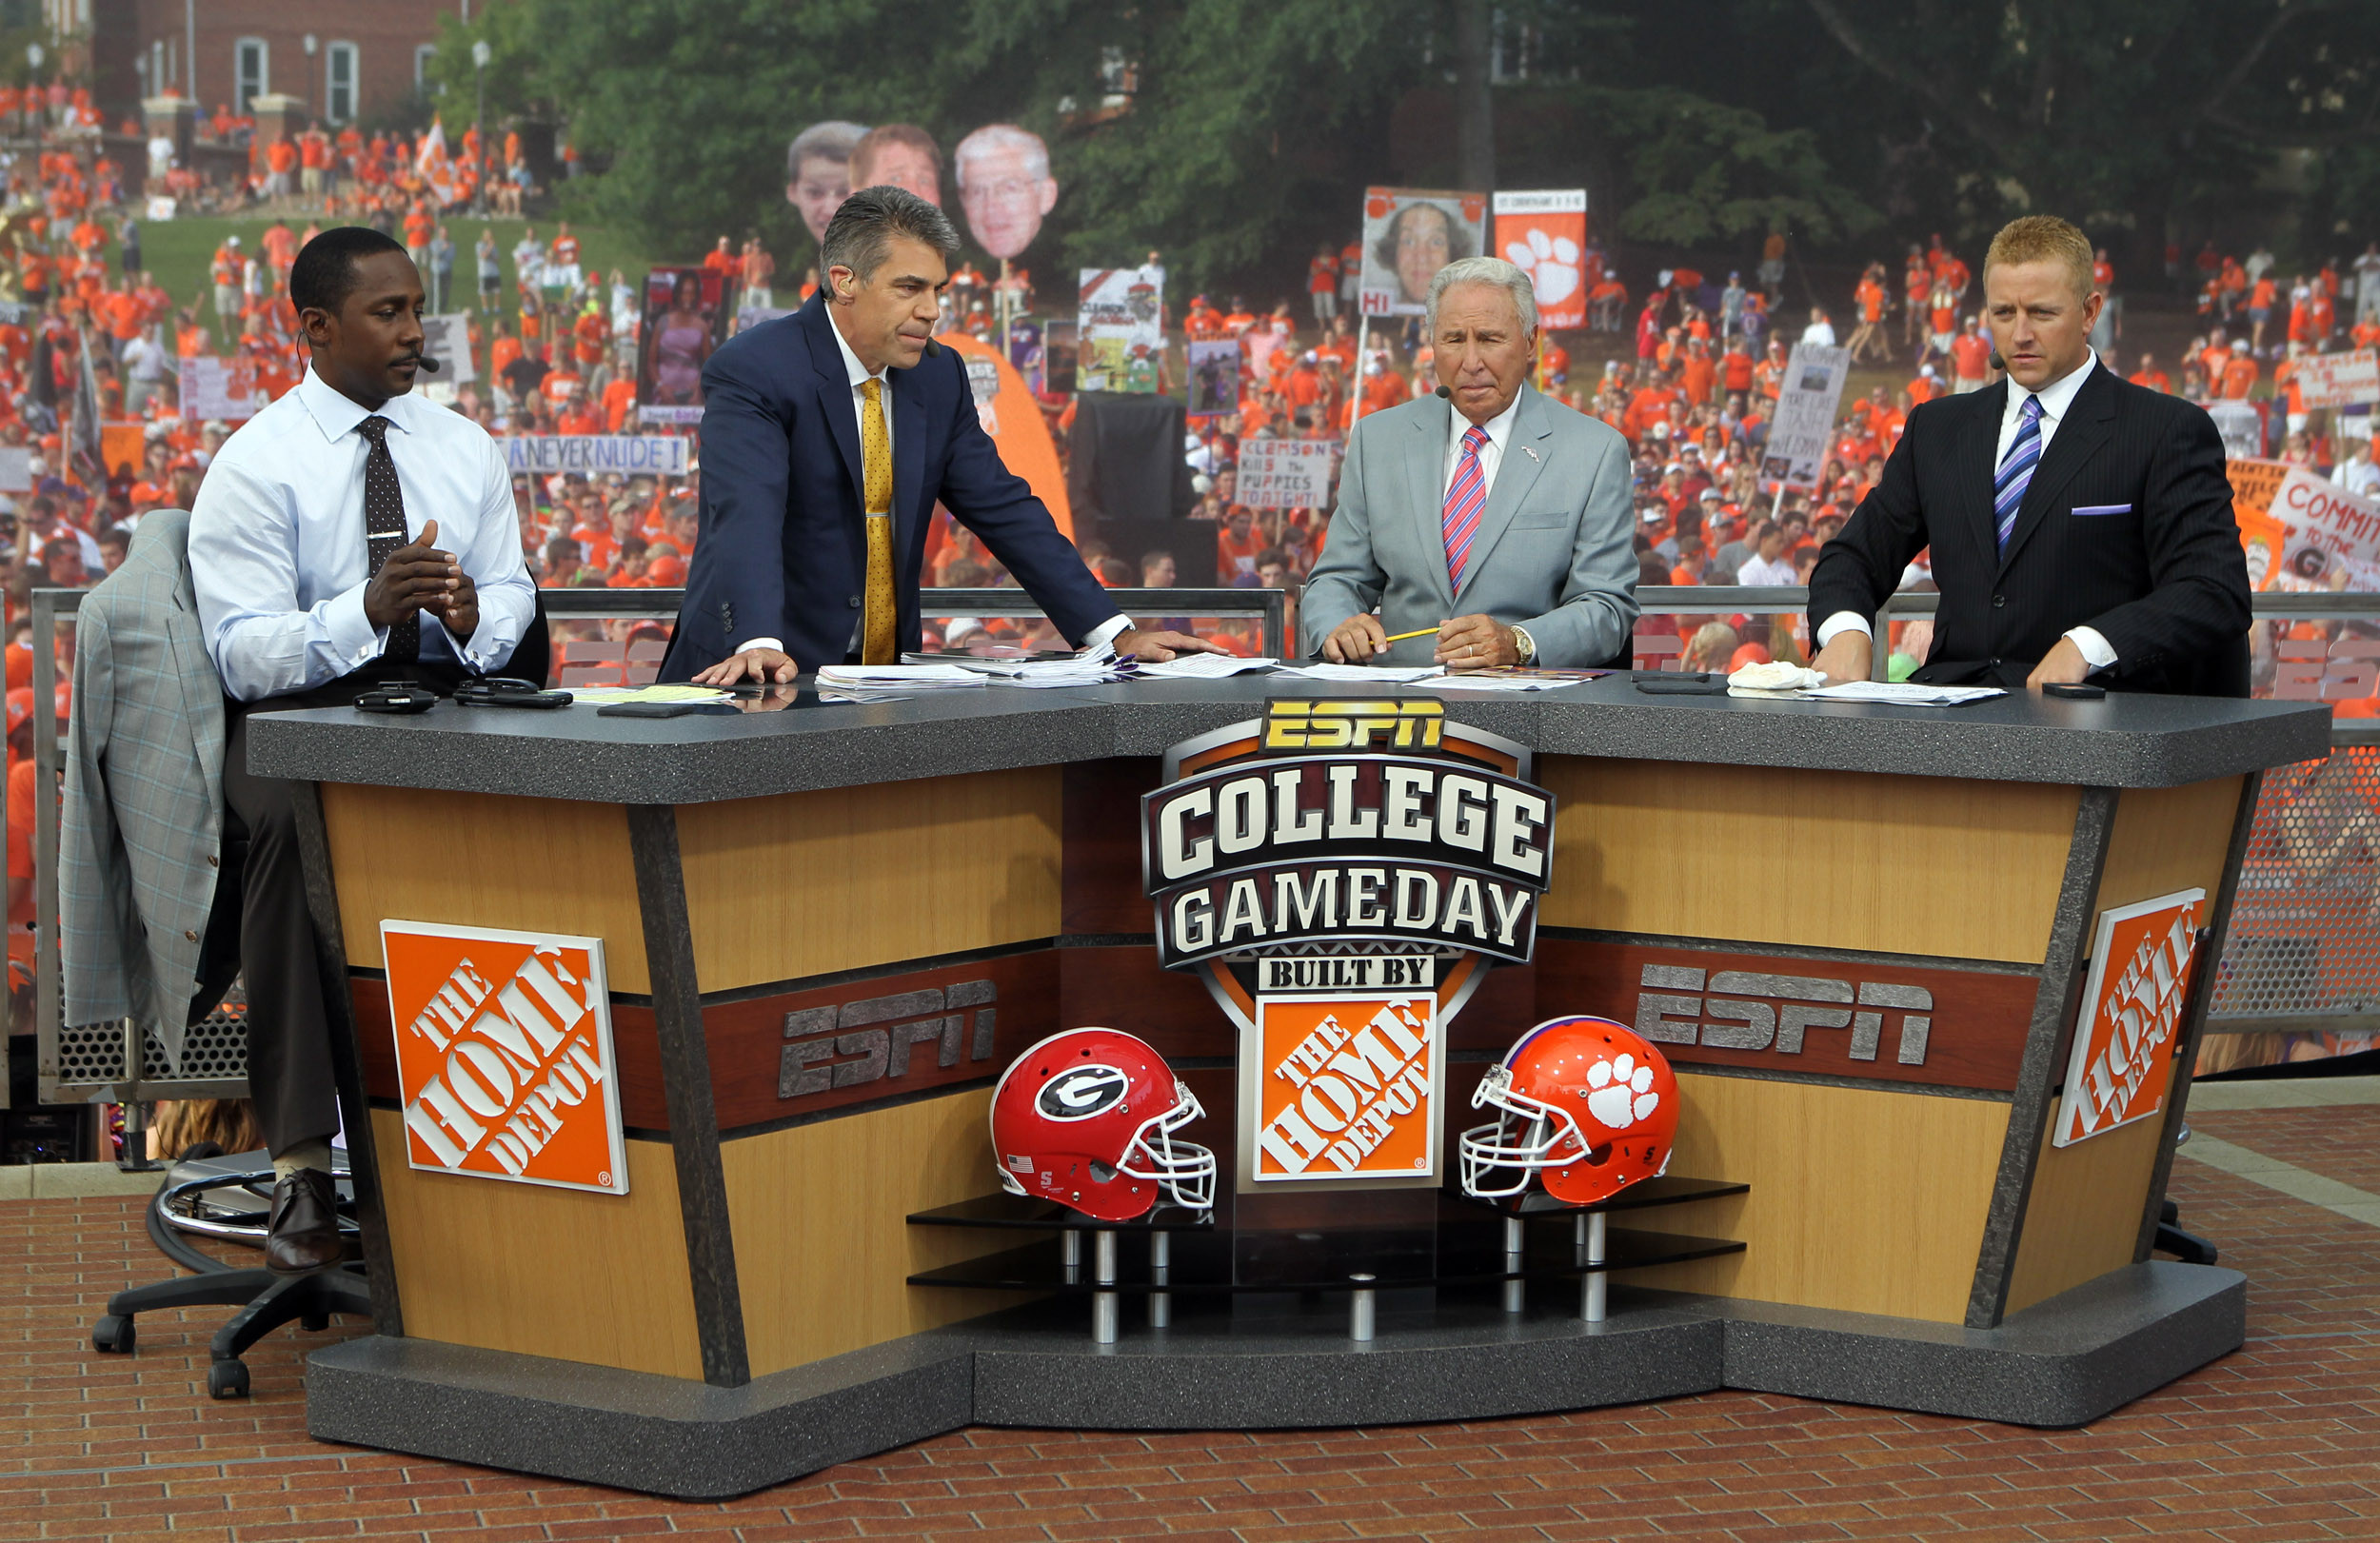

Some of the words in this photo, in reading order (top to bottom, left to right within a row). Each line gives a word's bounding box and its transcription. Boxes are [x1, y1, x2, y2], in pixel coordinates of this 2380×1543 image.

[1362, 291, 1389, 313] HI
[1243, 474, 1311, 490] PUPPIES
[1244, 441, 1326, 456] CLEMSON
[1265, 701, 1444, 749] ESPN
[1160, 765, 1547, 880] COLLEGE
[1174, 867, 1531, 953] GAMEDAY
[409, 956, 494, 1053] THE
[1269, 958, 1373, 987] BUILT
[1381, 958, 1428, 984] BY
[1634, 963, 1934, 1065] ESPN
[2073, 900, 2199, 1135] HOME
[2103, 929, 2155, 1027] THE
[405, 943, 598, 1170] HOME
[778, 979, 999, 1099] ESPN
[1260, 999, 1431, 1175] HOME
[1273, 1014, 1352, 1089] THE
[2110, 976, 2185, 1125] DEPOT
[486, 1033, 605, 1177] DEPOT
[1323, 1059, 1430, 1174] DEPOT
